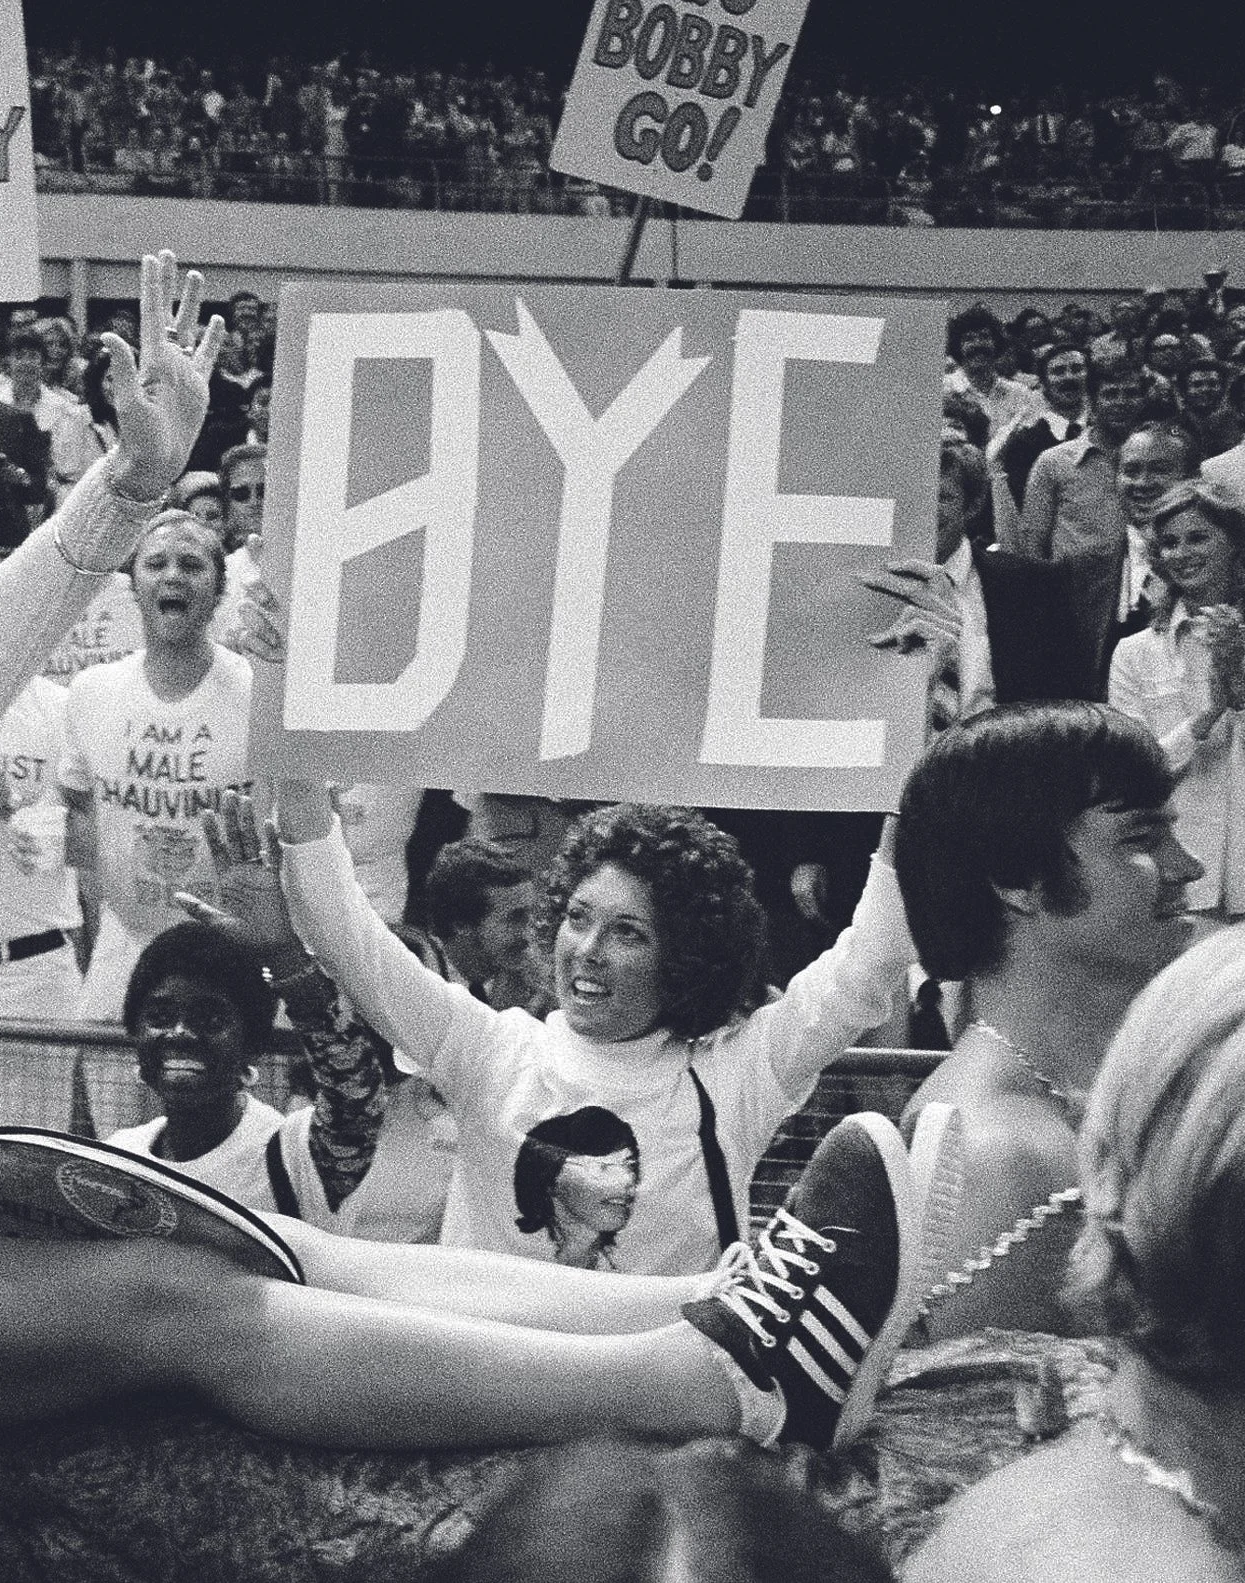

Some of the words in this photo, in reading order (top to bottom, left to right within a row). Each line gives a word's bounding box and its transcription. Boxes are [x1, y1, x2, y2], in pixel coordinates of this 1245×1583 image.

[592, 0, 791, 108] BOBBY
[614, 91, 742, 182] GO!
[283, 297, 895, 767] BYE
[126, 749, 207, 784] MALE
[142, 724, 183, 744] AM
[192, 724, 213, 743] A
